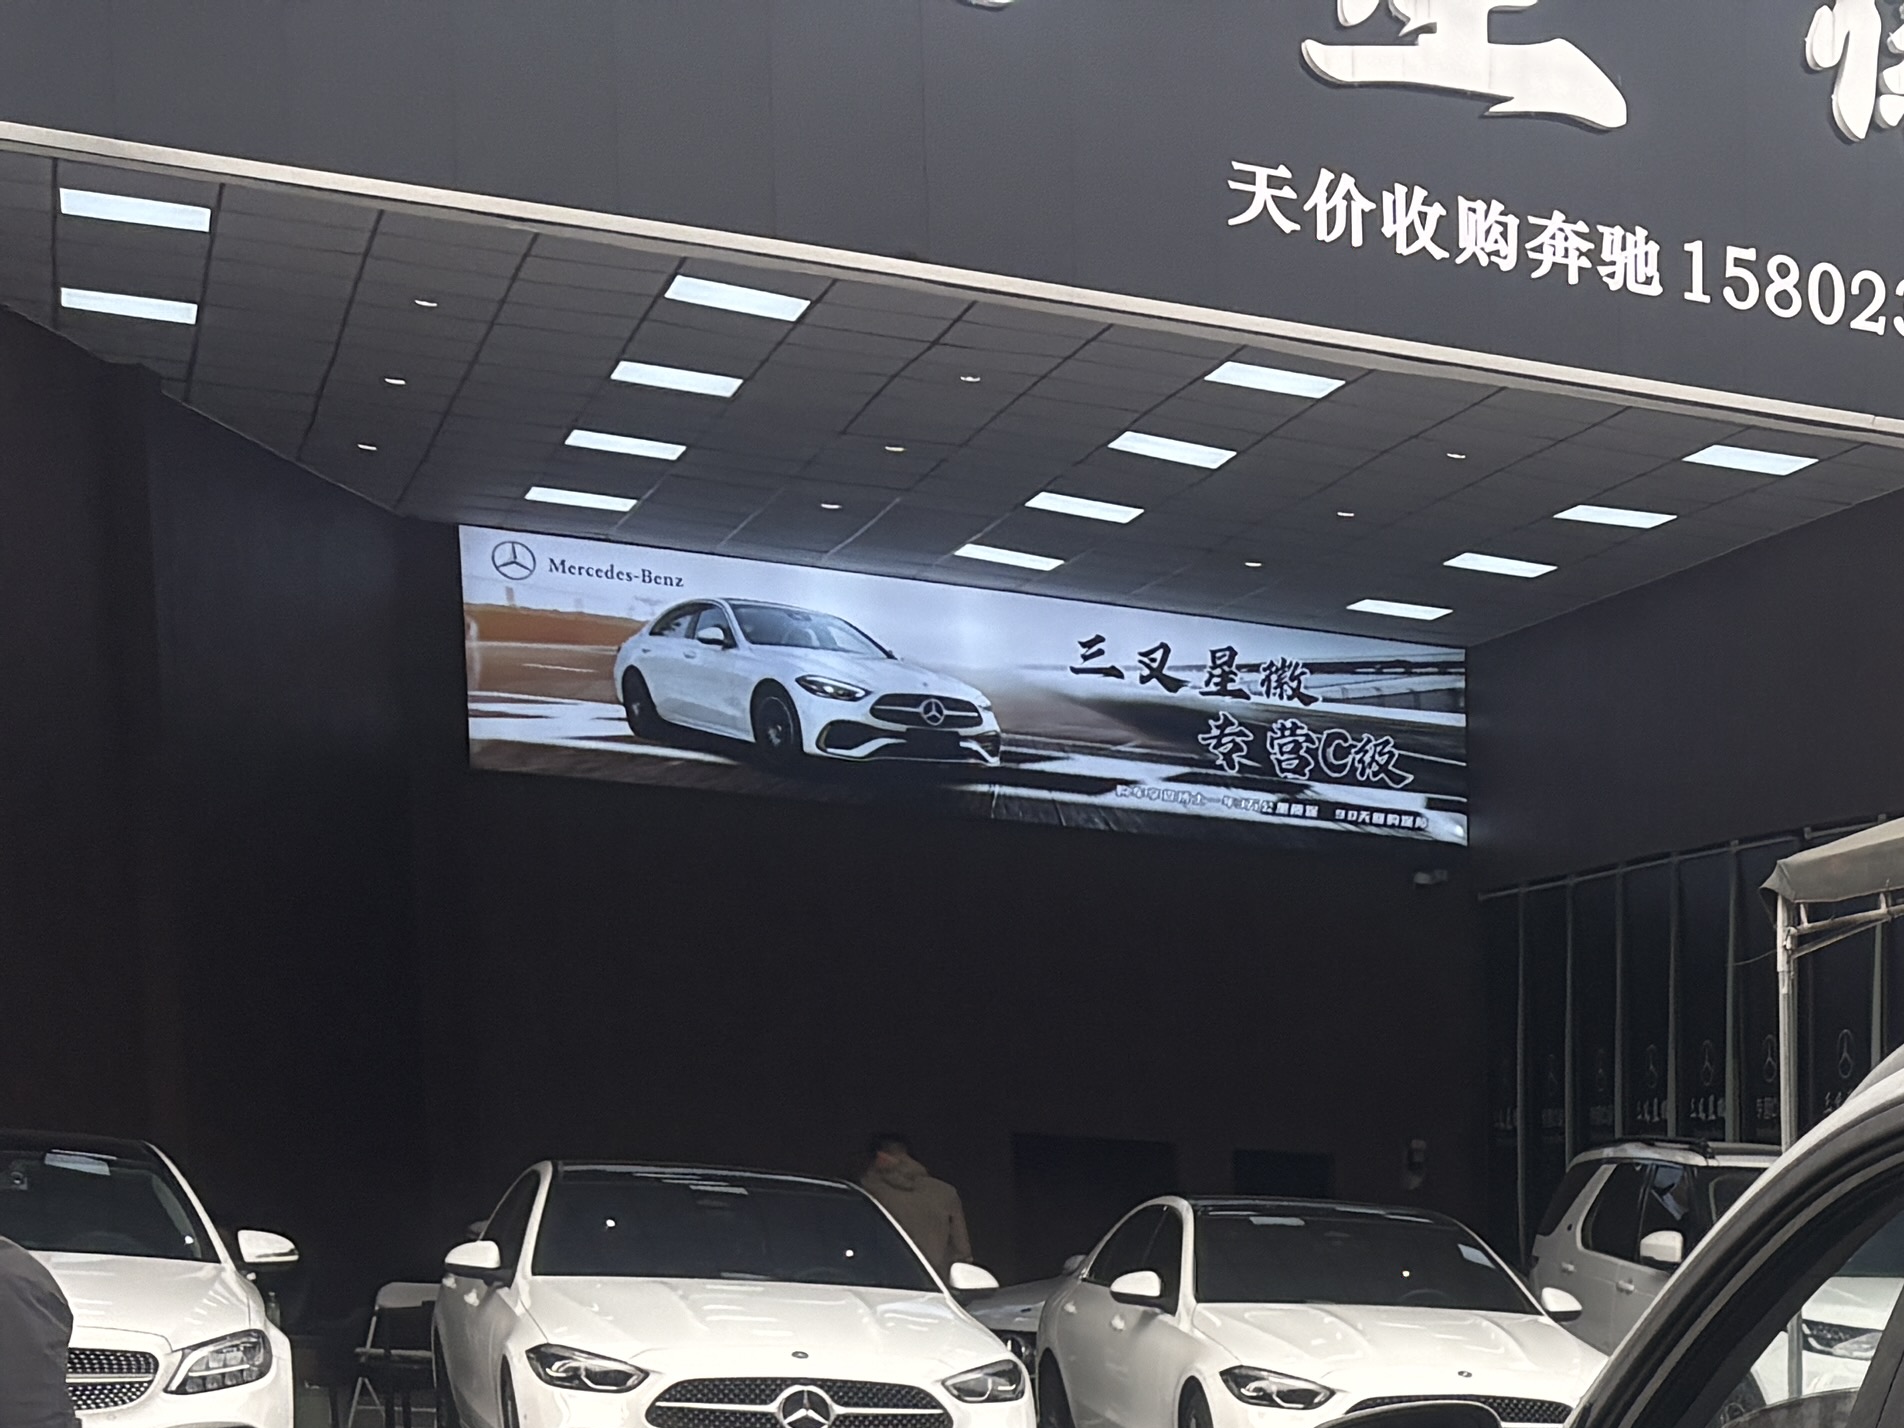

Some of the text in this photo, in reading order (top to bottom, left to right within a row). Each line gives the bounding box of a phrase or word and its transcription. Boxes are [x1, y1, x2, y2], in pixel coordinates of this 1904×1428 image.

[1227, 159, 1664, 298] 天价收购奔驰
[548, 557, 684, 588] Mercedes-Benz
[1068, 633, 1321, 707] 三叉星徽
